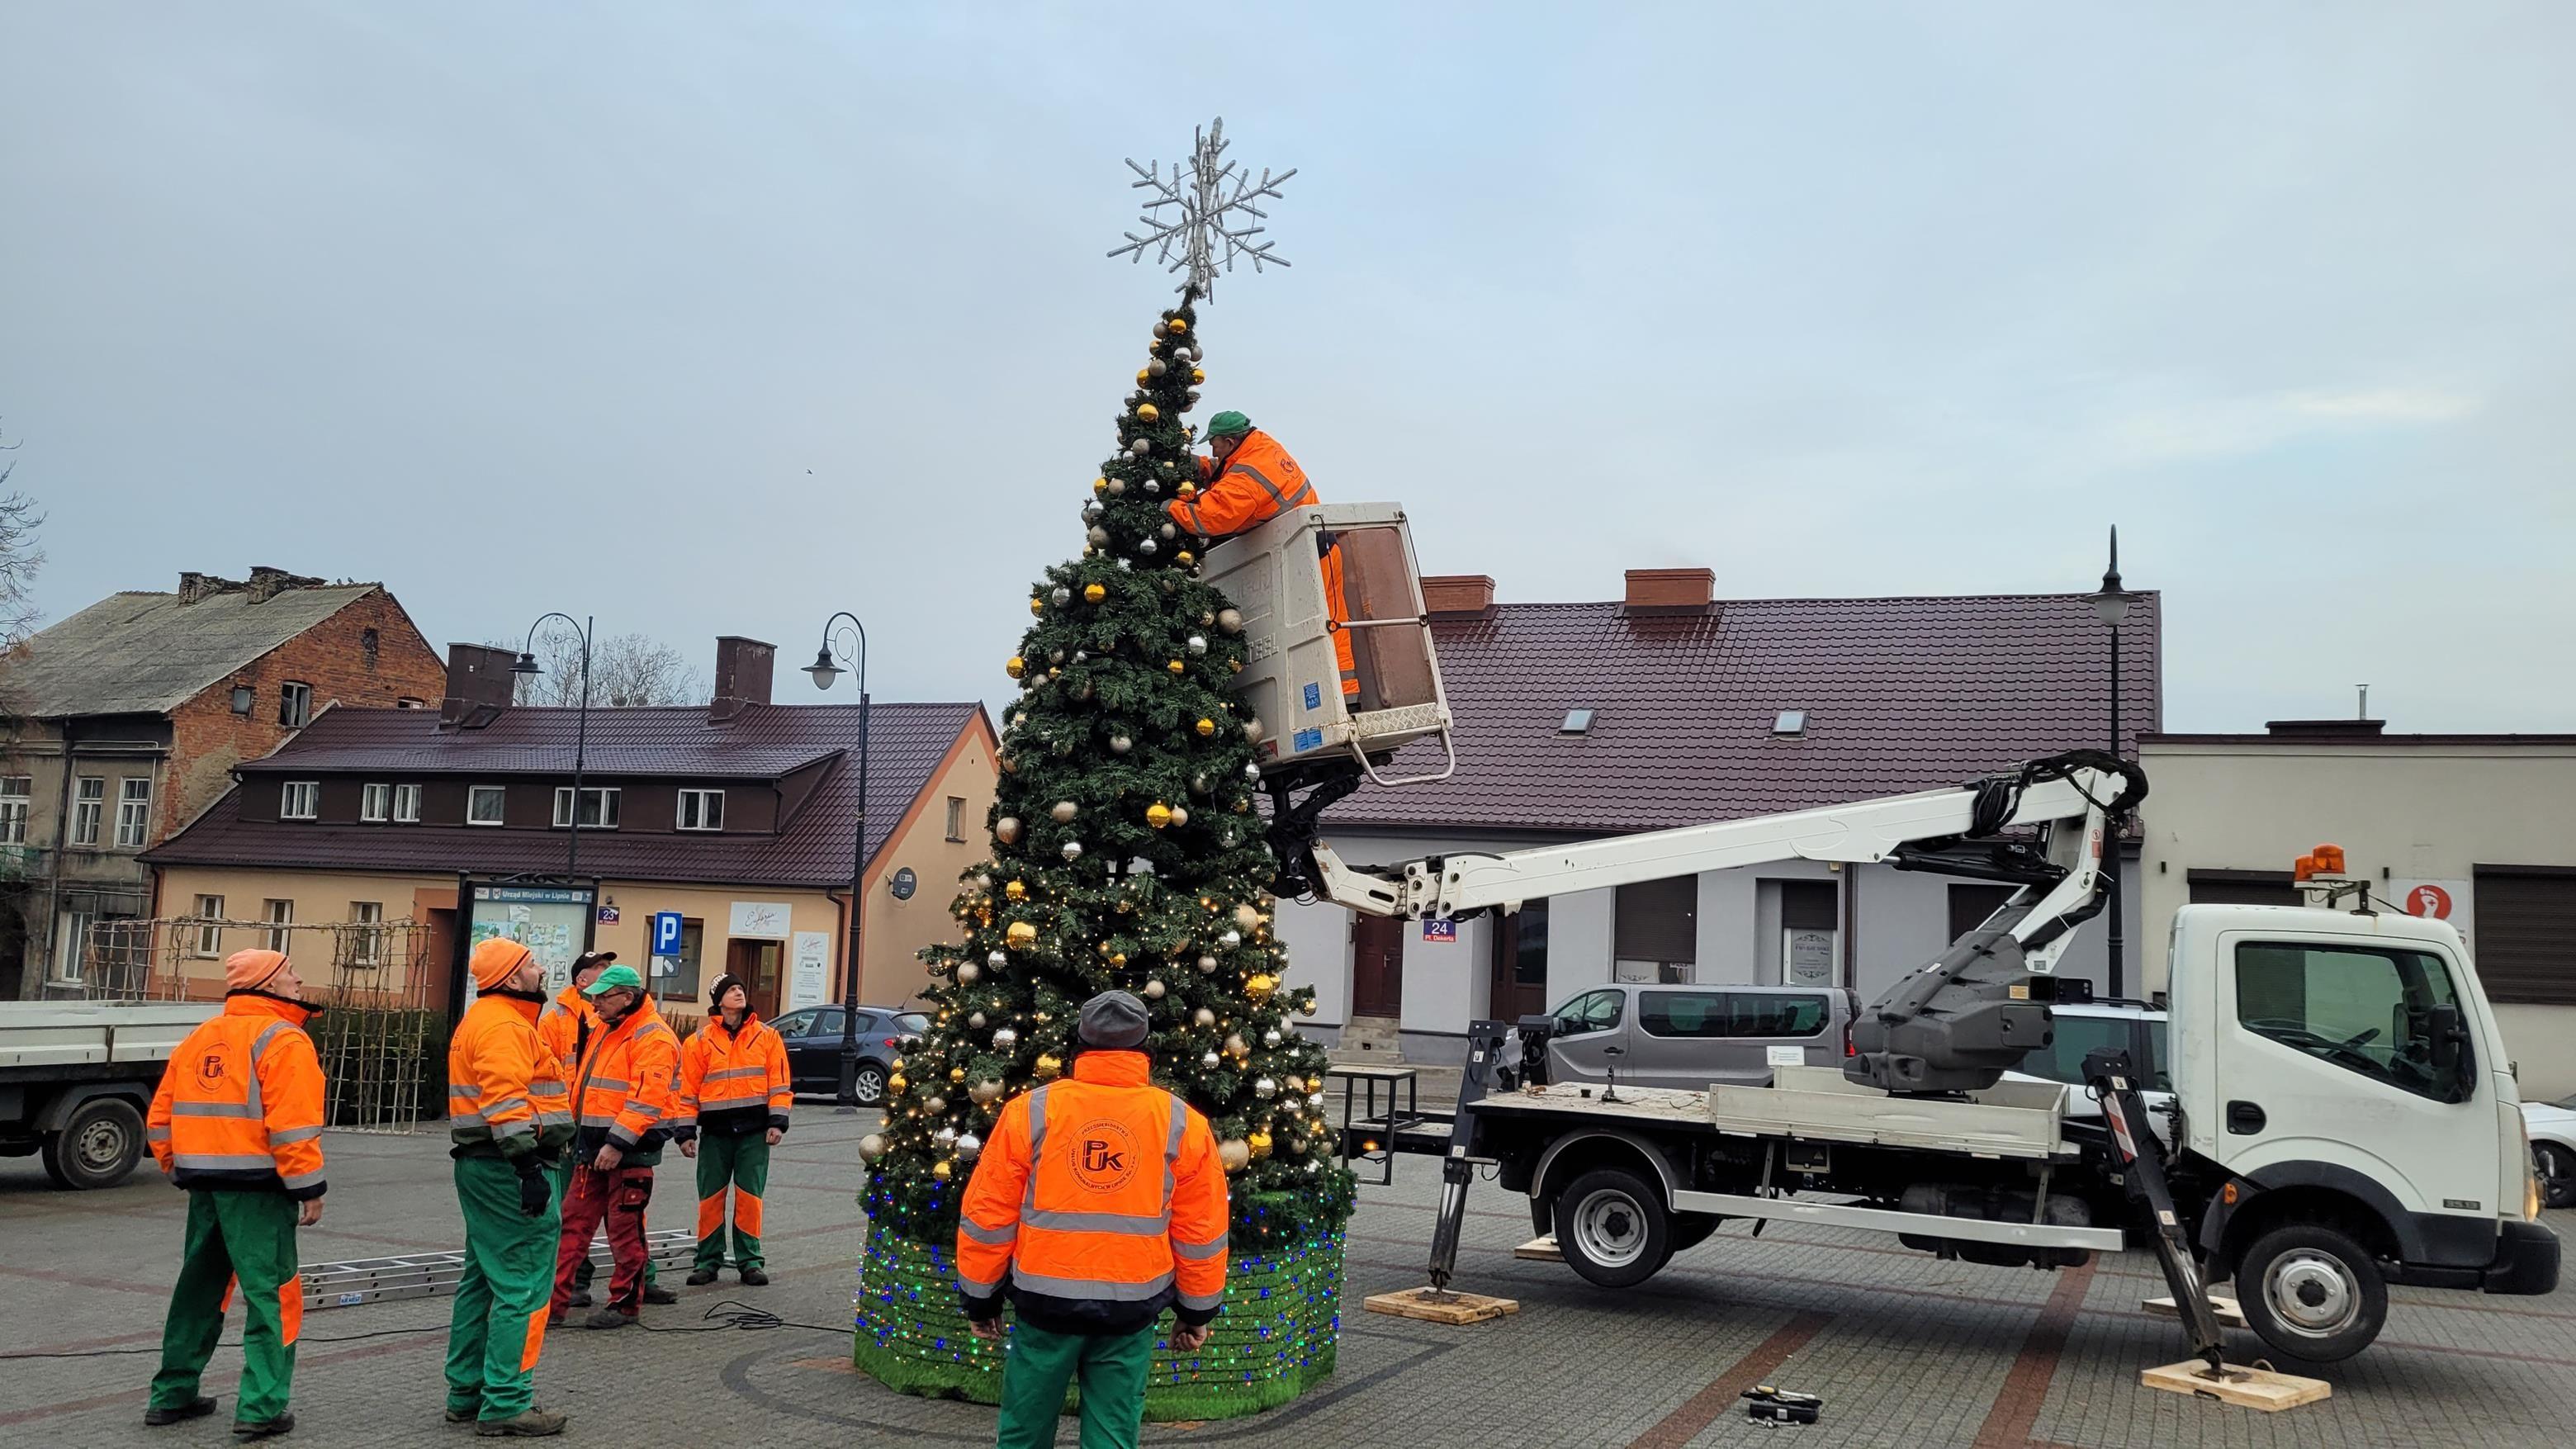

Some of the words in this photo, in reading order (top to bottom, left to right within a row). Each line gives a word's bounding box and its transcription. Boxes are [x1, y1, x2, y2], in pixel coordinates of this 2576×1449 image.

[1245, 632, 1279, 665] TEEL
[522, 891, 543, 900] Miejski
[552, 892, 570, 901] Lipnie
[603, 910, 614, 921] 23
[661, 916, 677, 949] P
[1431, 922, 1448, 935] 24
